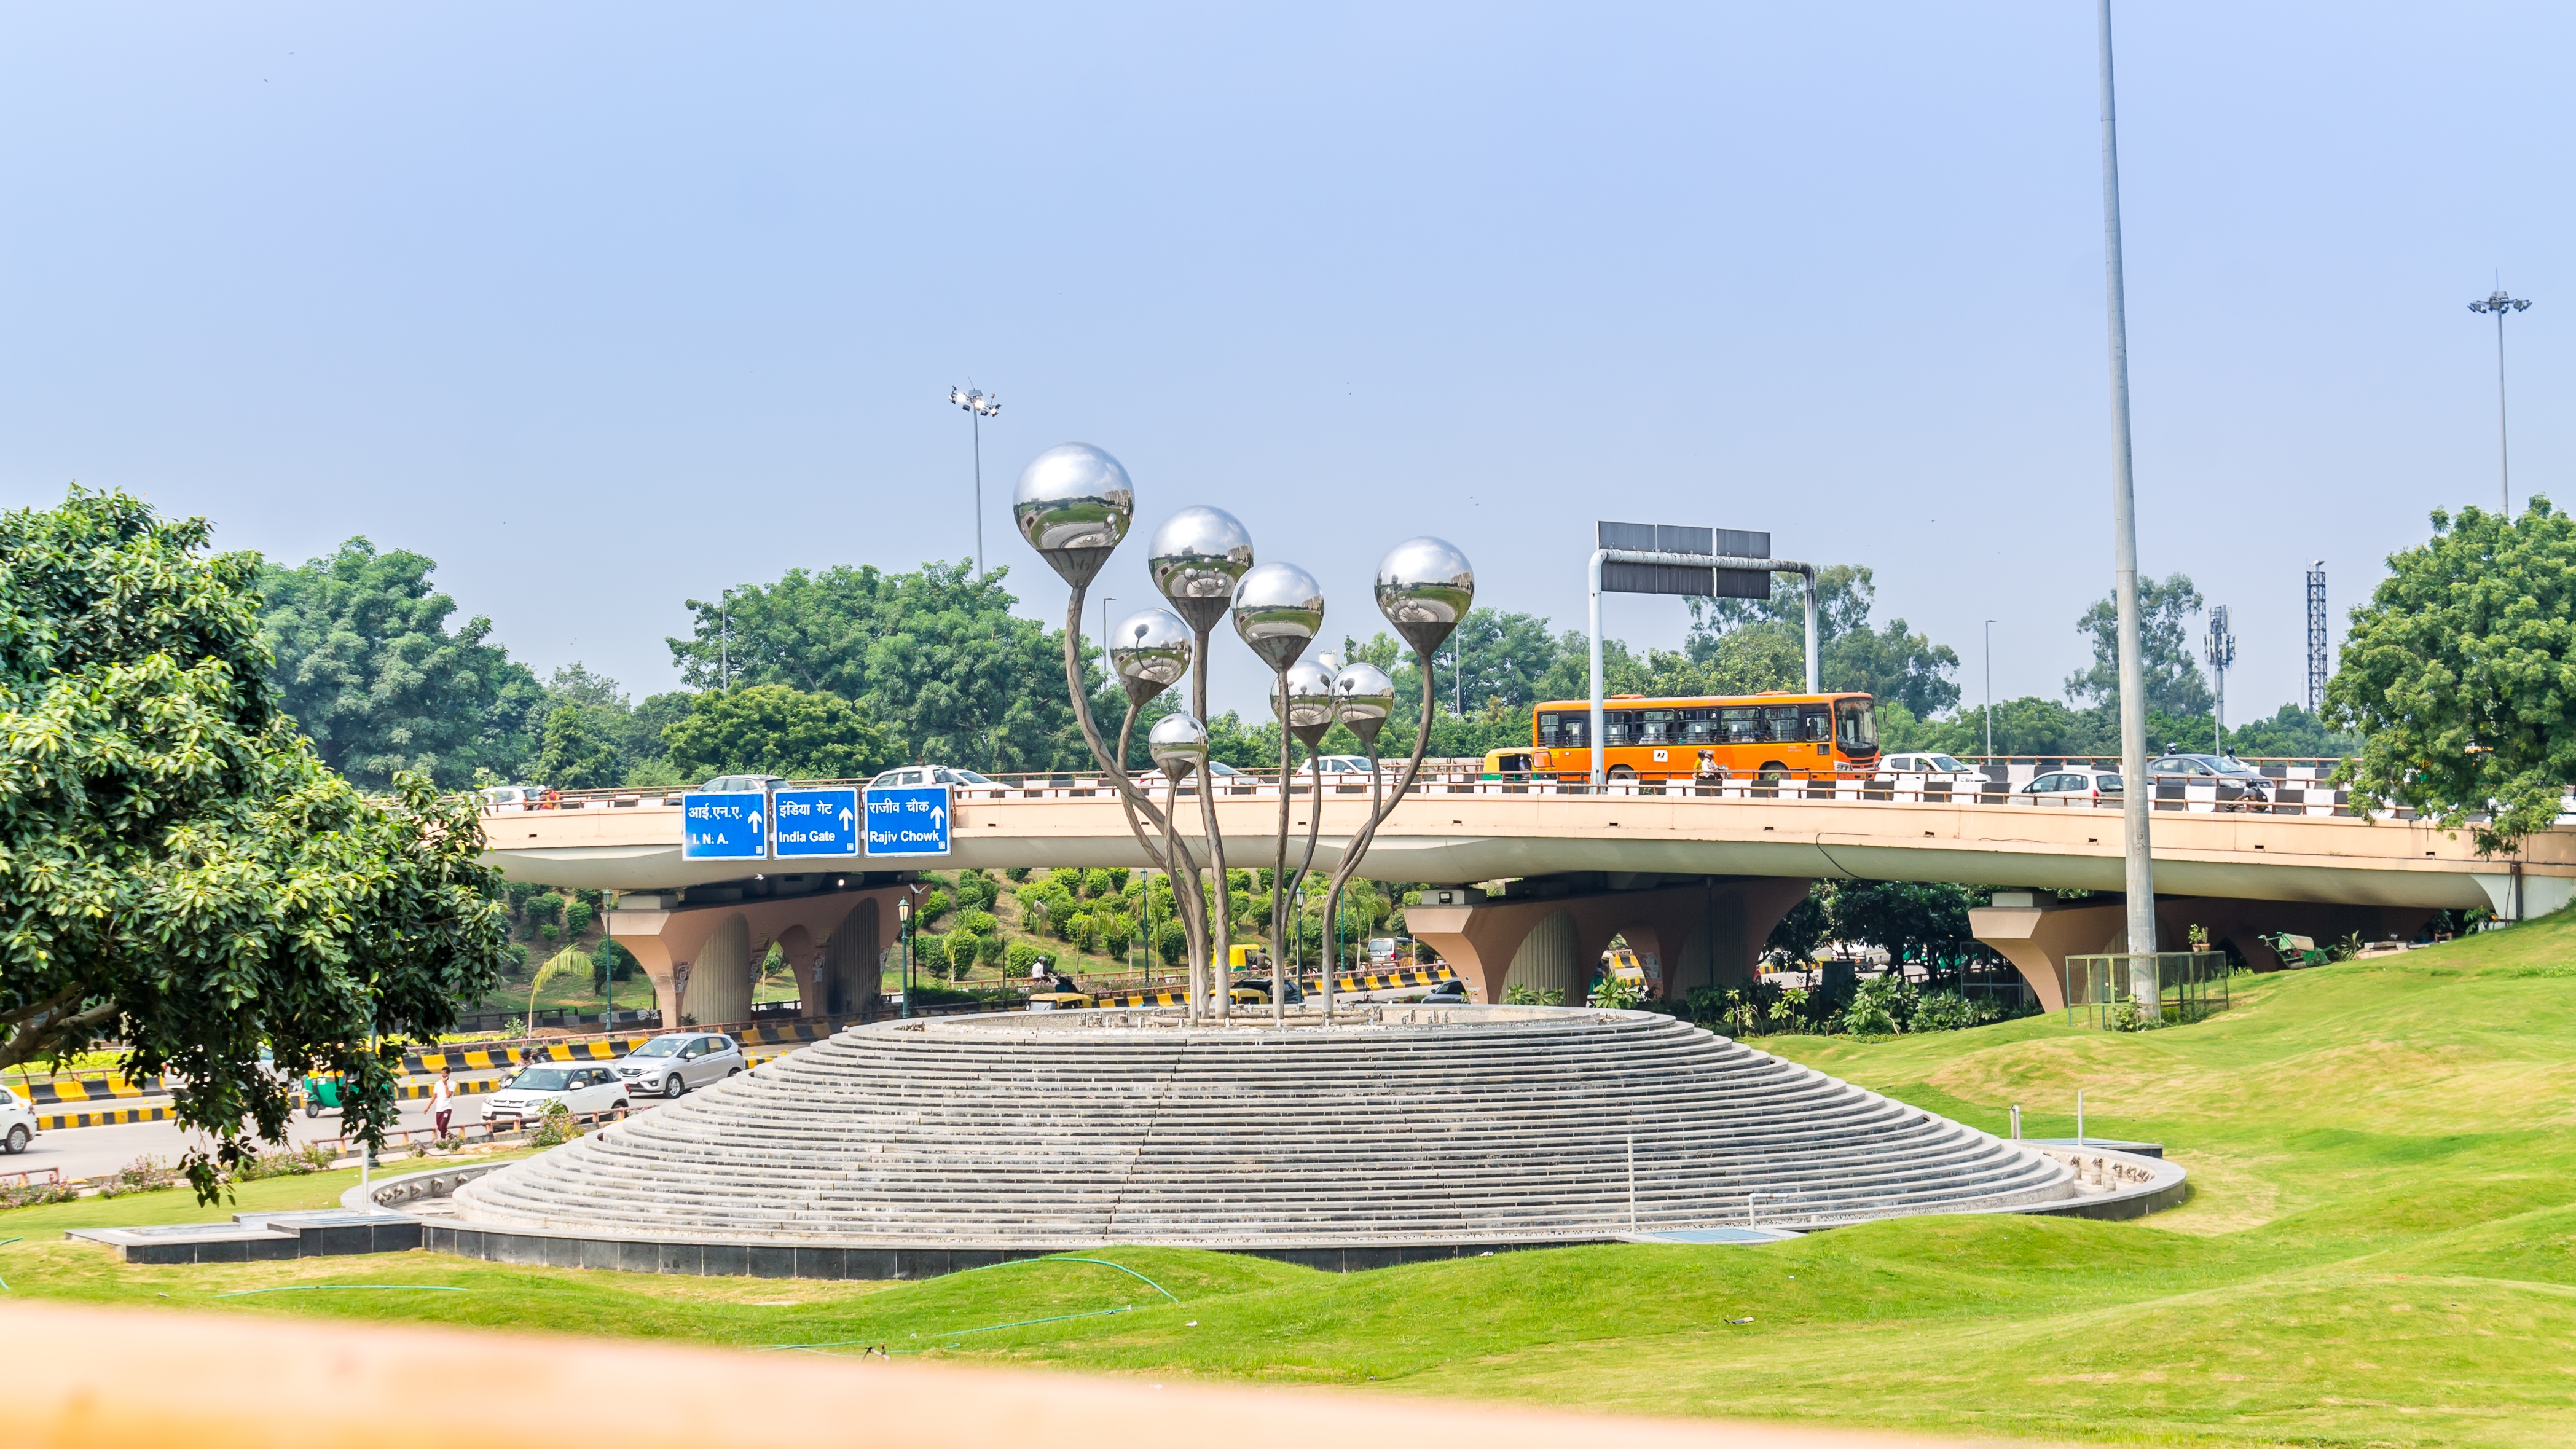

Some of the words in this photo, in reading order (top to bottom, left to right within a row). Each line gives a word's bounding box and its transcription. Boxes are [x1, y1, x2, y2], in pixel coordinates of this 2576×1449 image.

[779, 800, 811, 819] इंडिया
[815, 799, 833, 815] गेट
[868, 798, 900, 814] राजीव
[905, 797, 930, 813] चौक
[779, 831, 807, 842] India
[809, 830, 836, 842] Gate
[870, 830, 898, 845] Rajiv
[900, 830, 940, 842] Chowk
